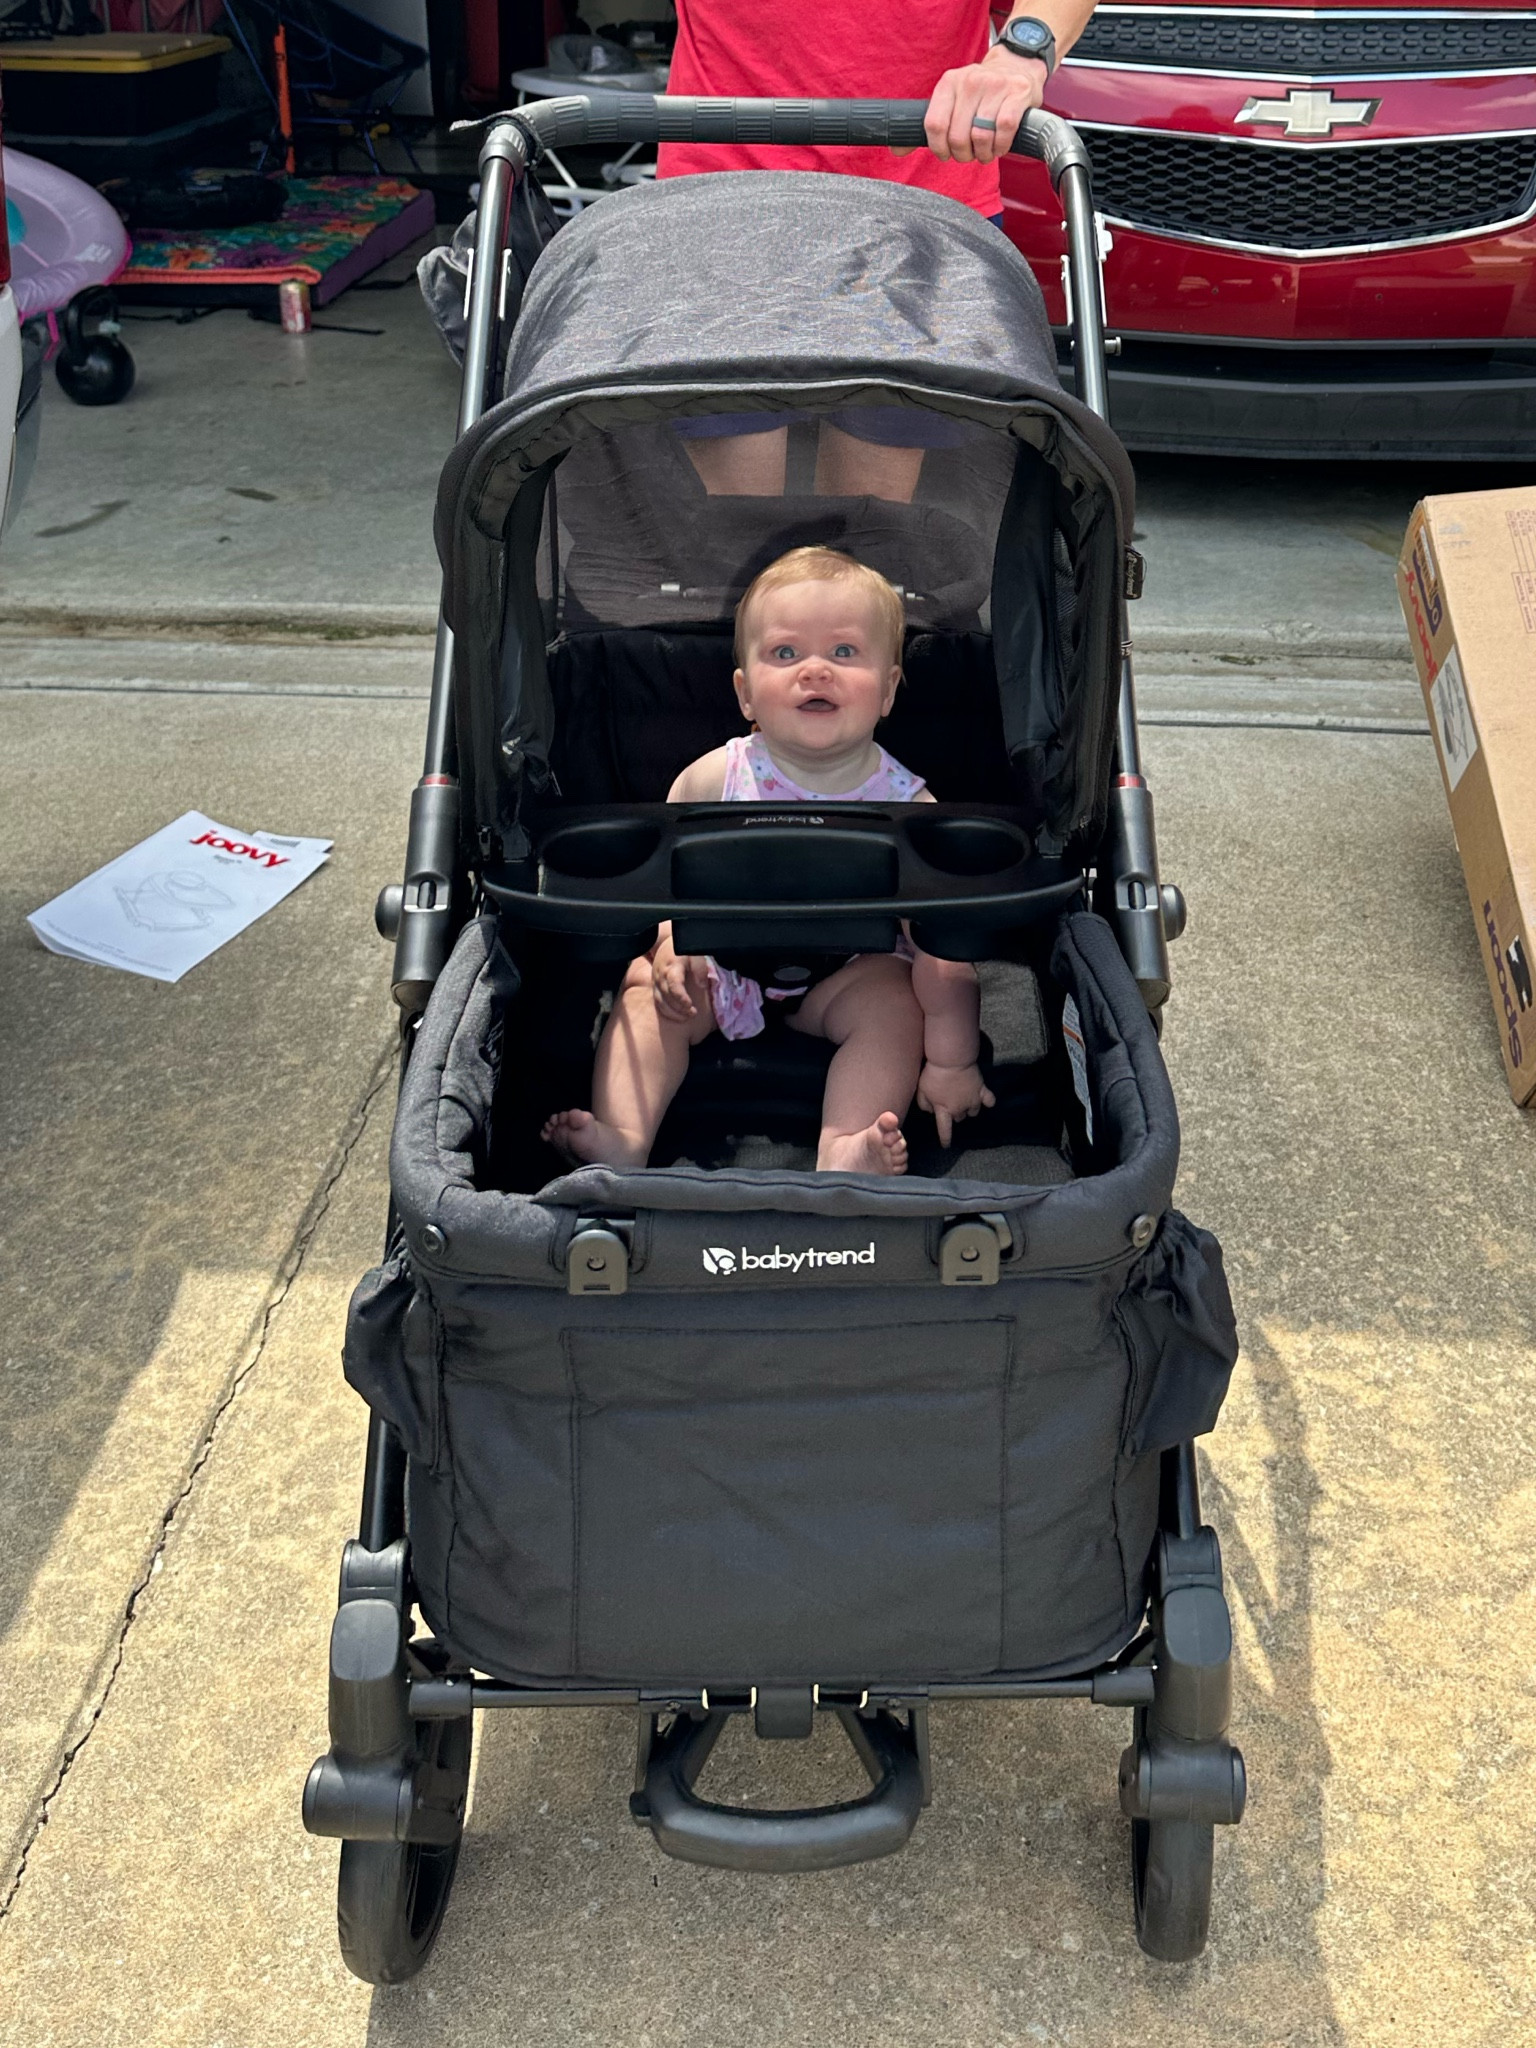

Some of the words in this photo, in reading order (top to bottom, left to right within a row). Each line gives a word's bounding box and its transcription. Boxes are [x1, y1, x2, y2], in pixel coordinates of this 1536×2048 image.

[1405, 571, 1438, 687] joovy
[742, 815, 806, 825] babytrend
[189, 829, 291, 868] joovy
[741, 1242, 875, 1273] babytrend
